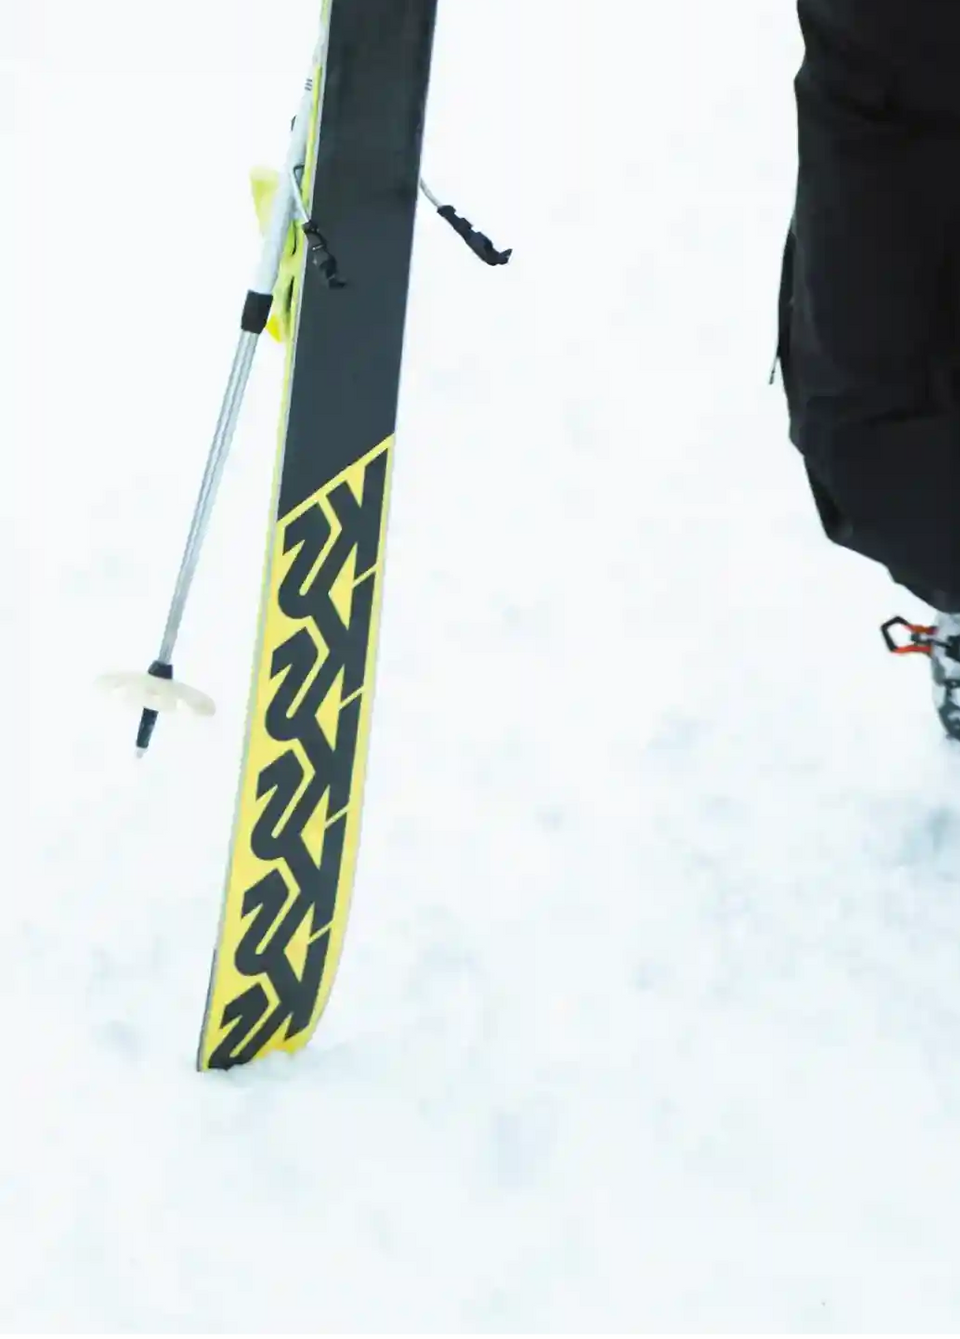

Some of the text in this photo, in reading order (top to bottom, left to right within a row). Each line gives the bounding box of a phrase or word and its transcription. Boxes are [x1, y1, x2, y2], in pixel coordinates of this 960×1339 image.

[278, 448, 388, 619] K2
[265, 571, 375, 741] K2
[251, 694, 362, 861] K2
[234, 811, 347, 976] K2
